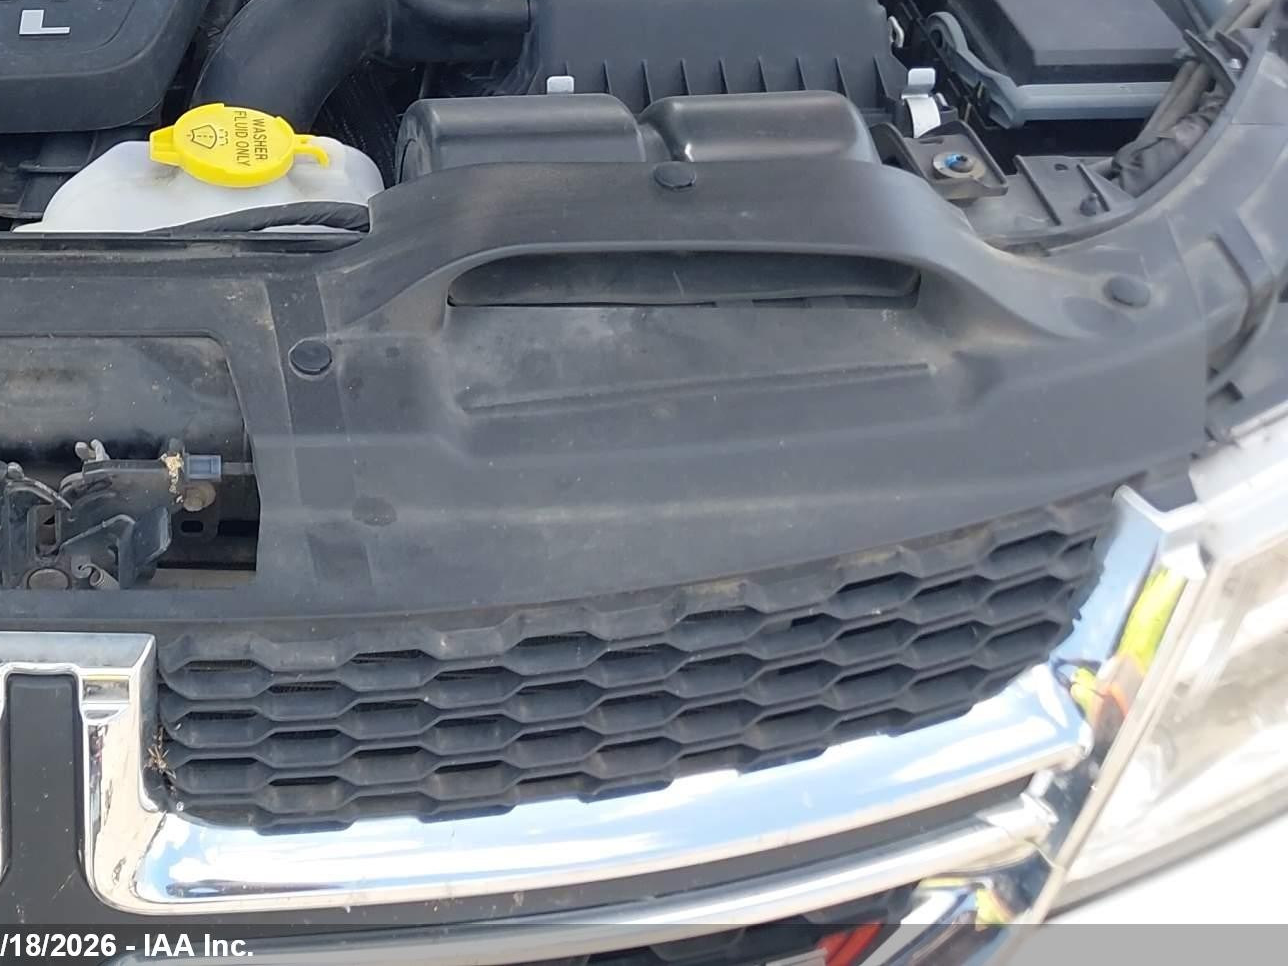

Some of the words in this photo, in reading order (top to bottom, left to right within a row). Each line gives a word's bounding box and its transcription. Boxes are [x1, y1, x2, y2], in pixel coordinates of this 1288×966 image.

[233, 110, 248, 138] FLUID
[235, 140, 251, 166] ONLY
[252, 118, 268, 160] WASHER
